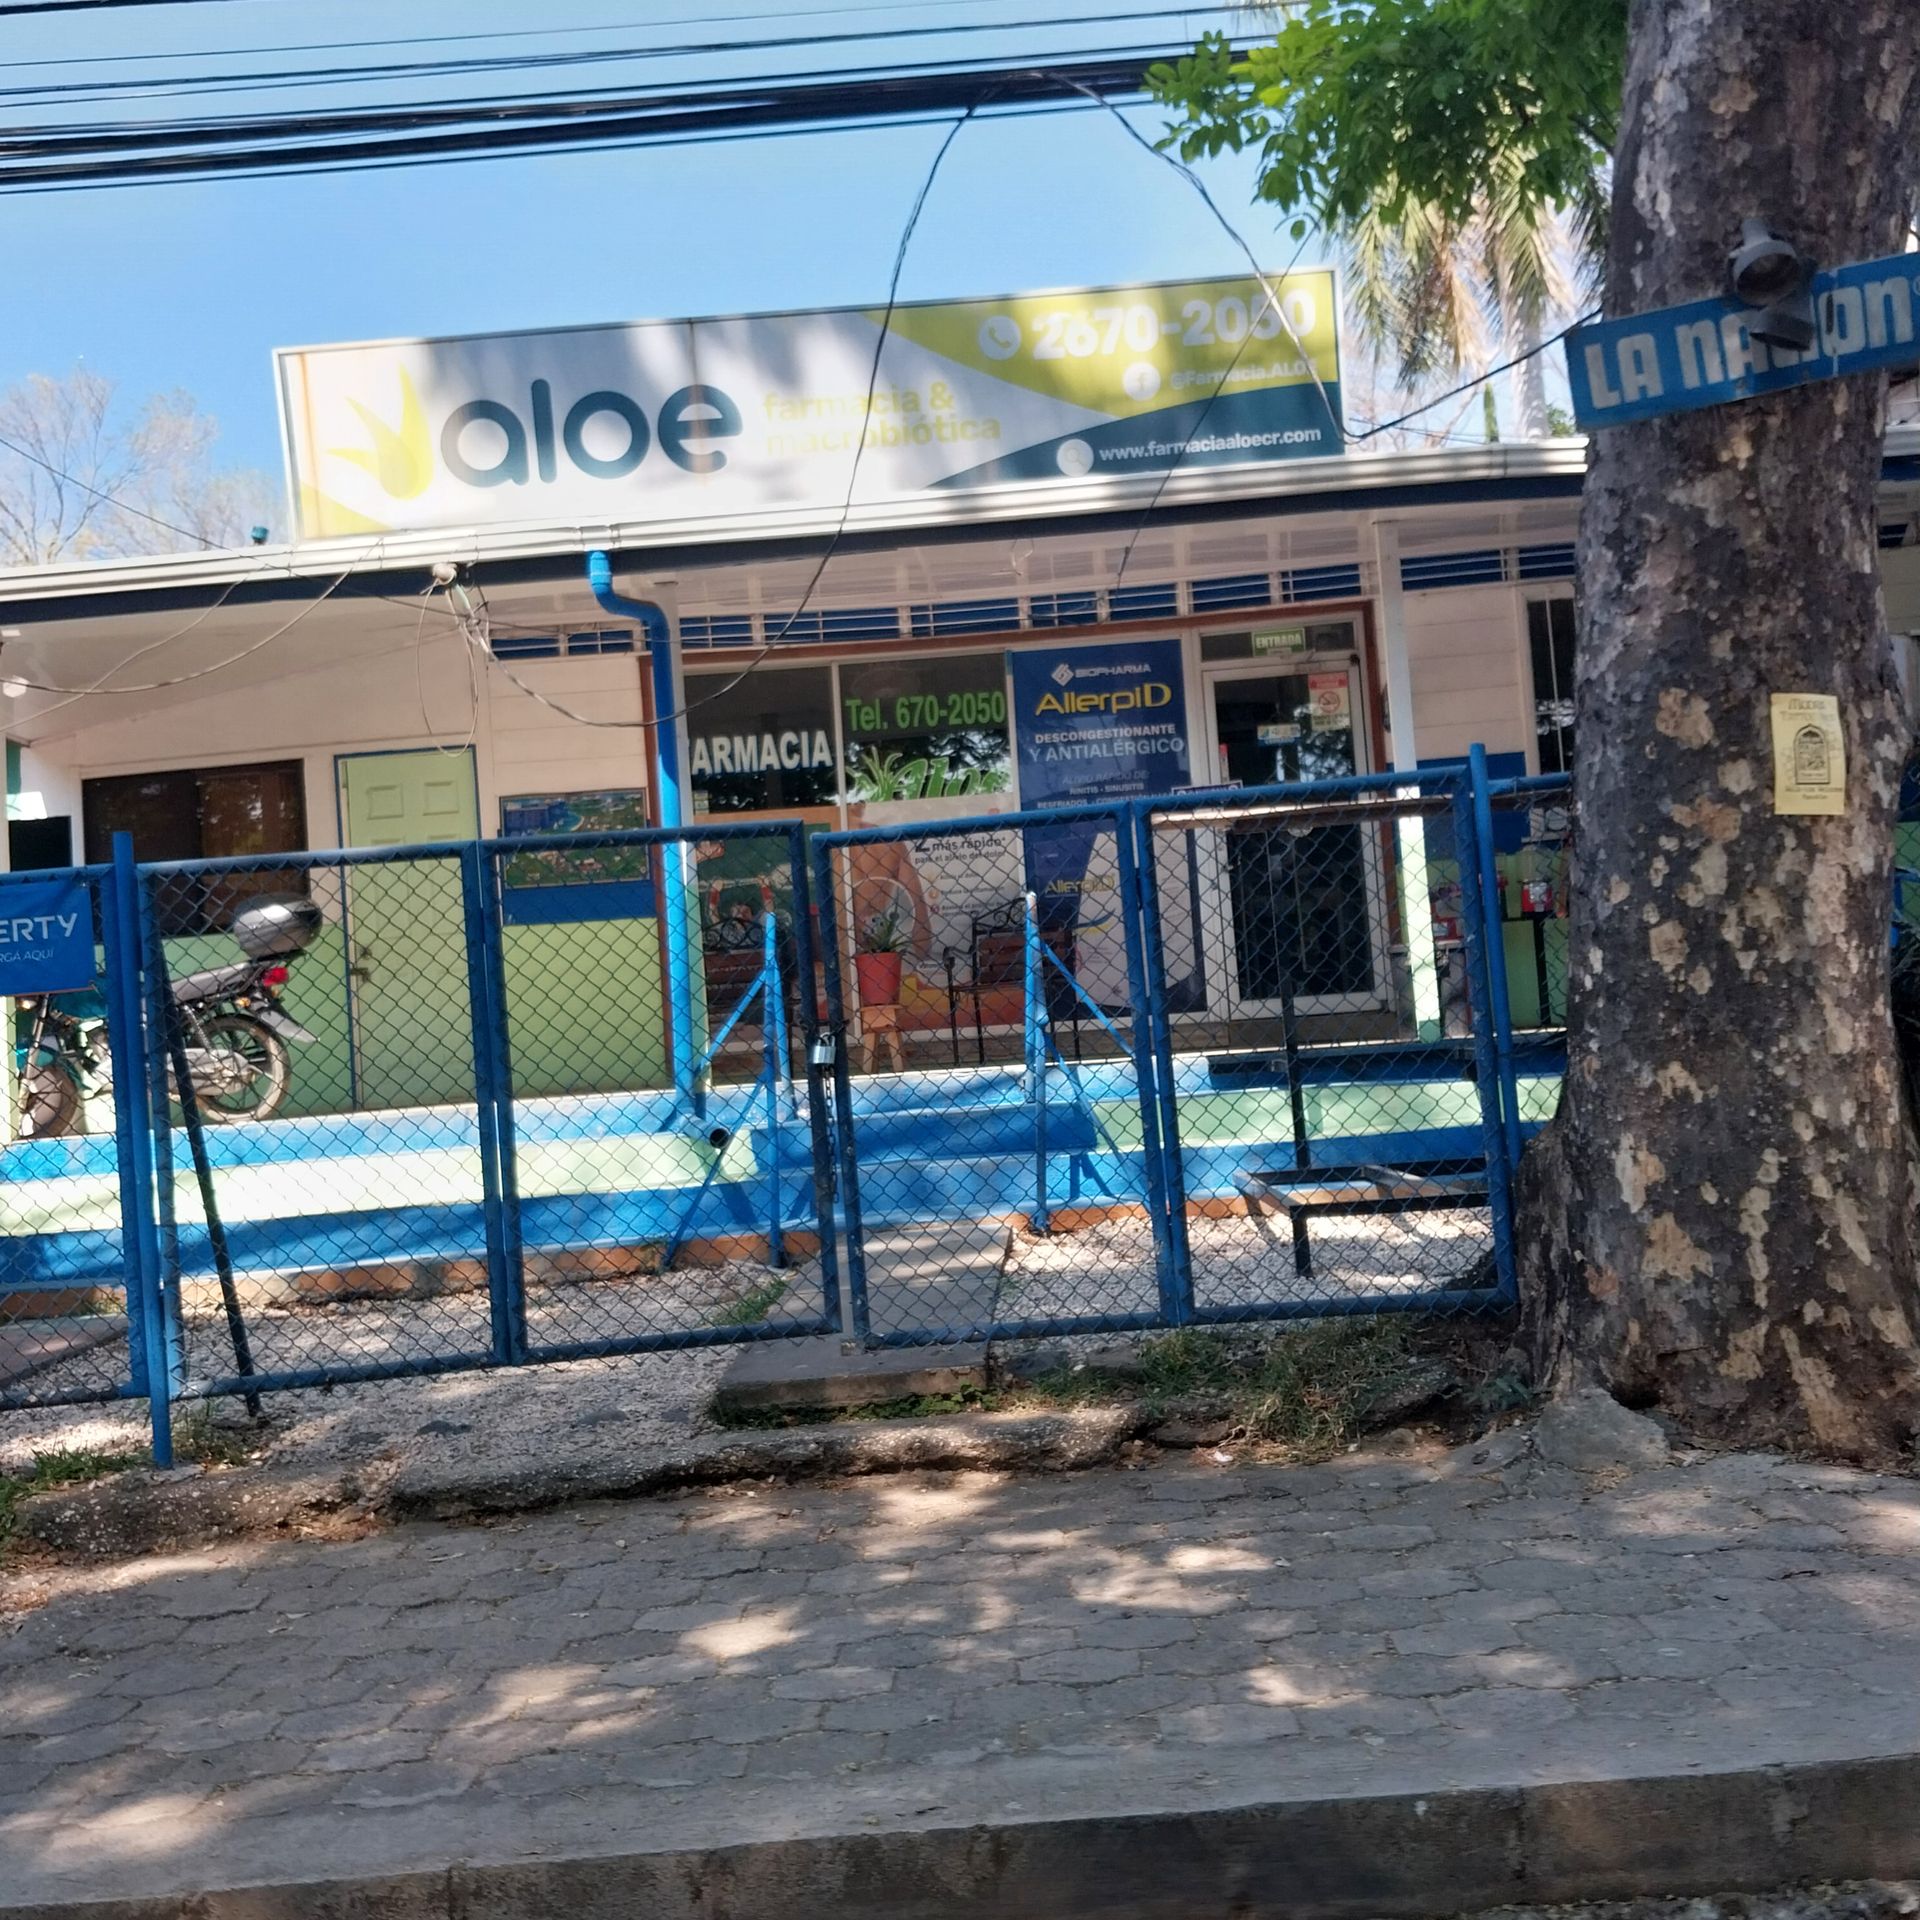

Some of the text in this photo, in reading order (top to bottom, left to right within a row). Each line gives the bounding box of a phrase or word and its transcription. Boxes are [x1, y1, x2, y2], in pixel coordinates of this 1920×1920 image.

[1031, 288, 1317, 361] 2670-2050
[1584, 332, 1664, 410] LA
[763, 380, 955, 424] farmacia &
[440, 378, 742, 488] aloe
[766, 412, 1000, 456] macrobiótica
[1099, 426, 1322, 462] www.farmaciaaloecr.com
[1255, 633, 1302, 648] ENTRADA
[845, 690, 1007, 732] Tel. 670-2050
[688, 730, 834, 776] ARMACIA
[1029, 736, 1185, 763] Y ANTIALÉRGICO
[1034, 723, 1177, 745] DESCONGESTIONANTE
